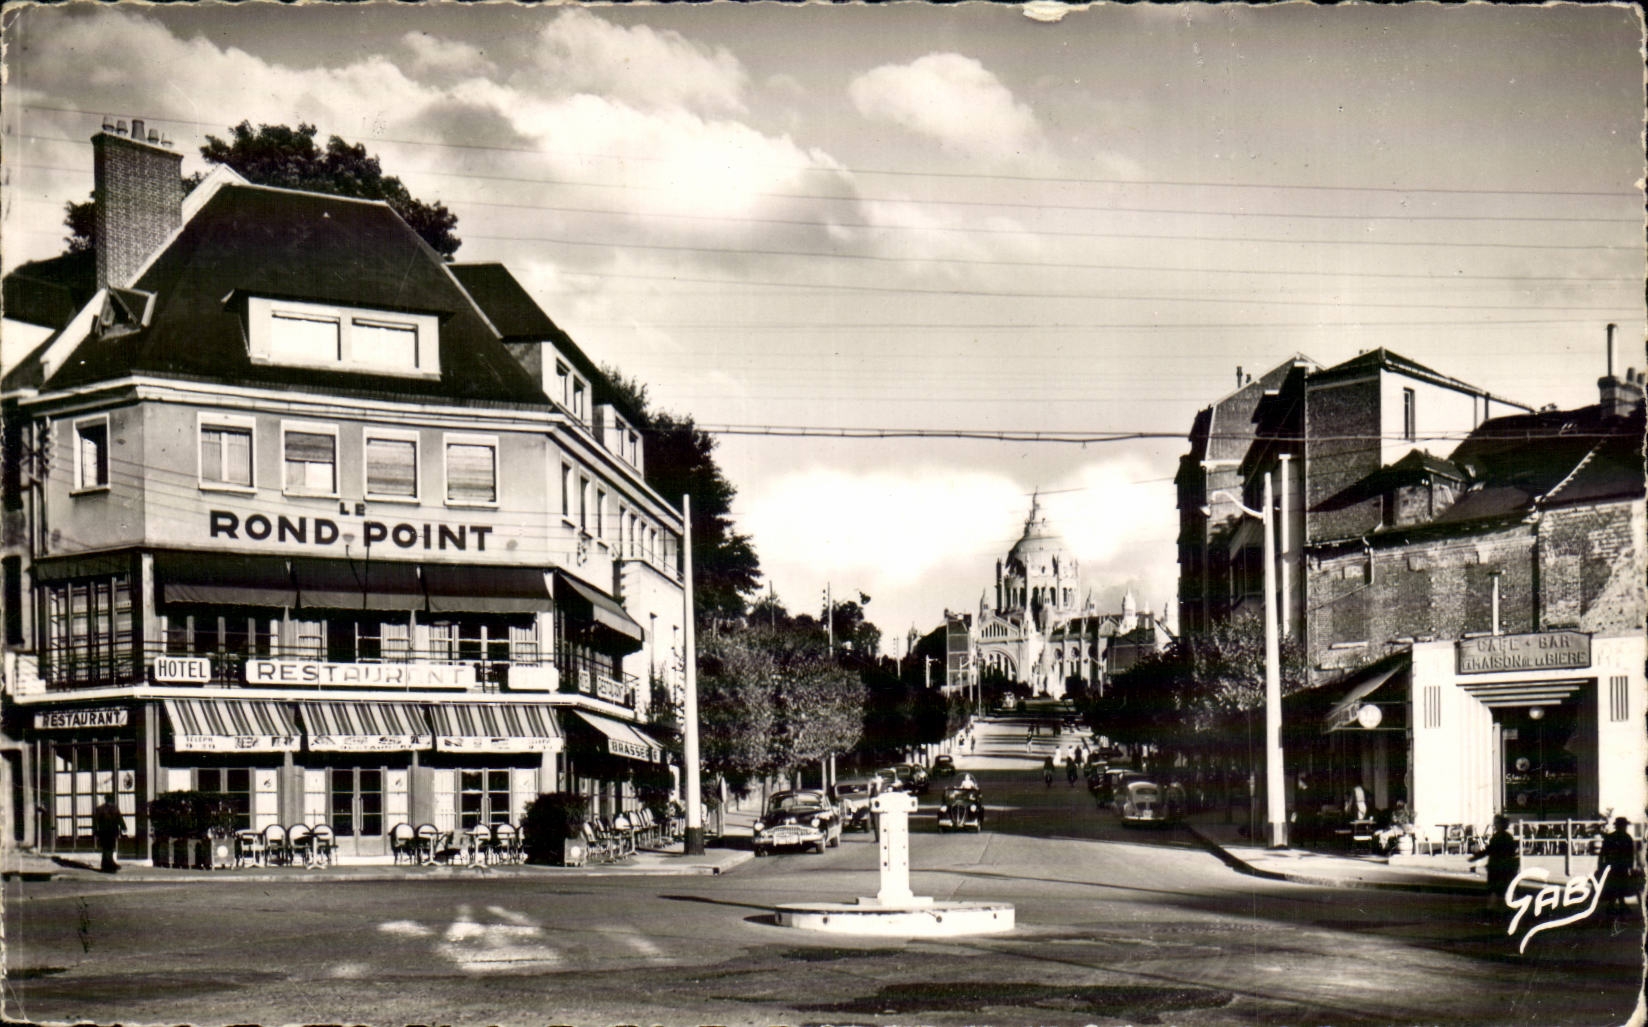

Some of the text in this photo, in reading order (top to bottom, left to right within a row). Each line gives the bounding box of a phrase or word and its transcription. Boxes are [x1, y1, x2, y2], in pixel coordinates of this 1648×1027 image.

[339, 502, 365, 517] LE
[210, 510, 493, 551] ROND POINT
[1539, 635, 1570, 649] BAR
[1472, 654, 1521, 669] MAISON
[1545, 651, 1586, 666] BIERE
[158, 660, 207, 679] HOTEL
[42, 710, 121, 728] RESTAURANT
